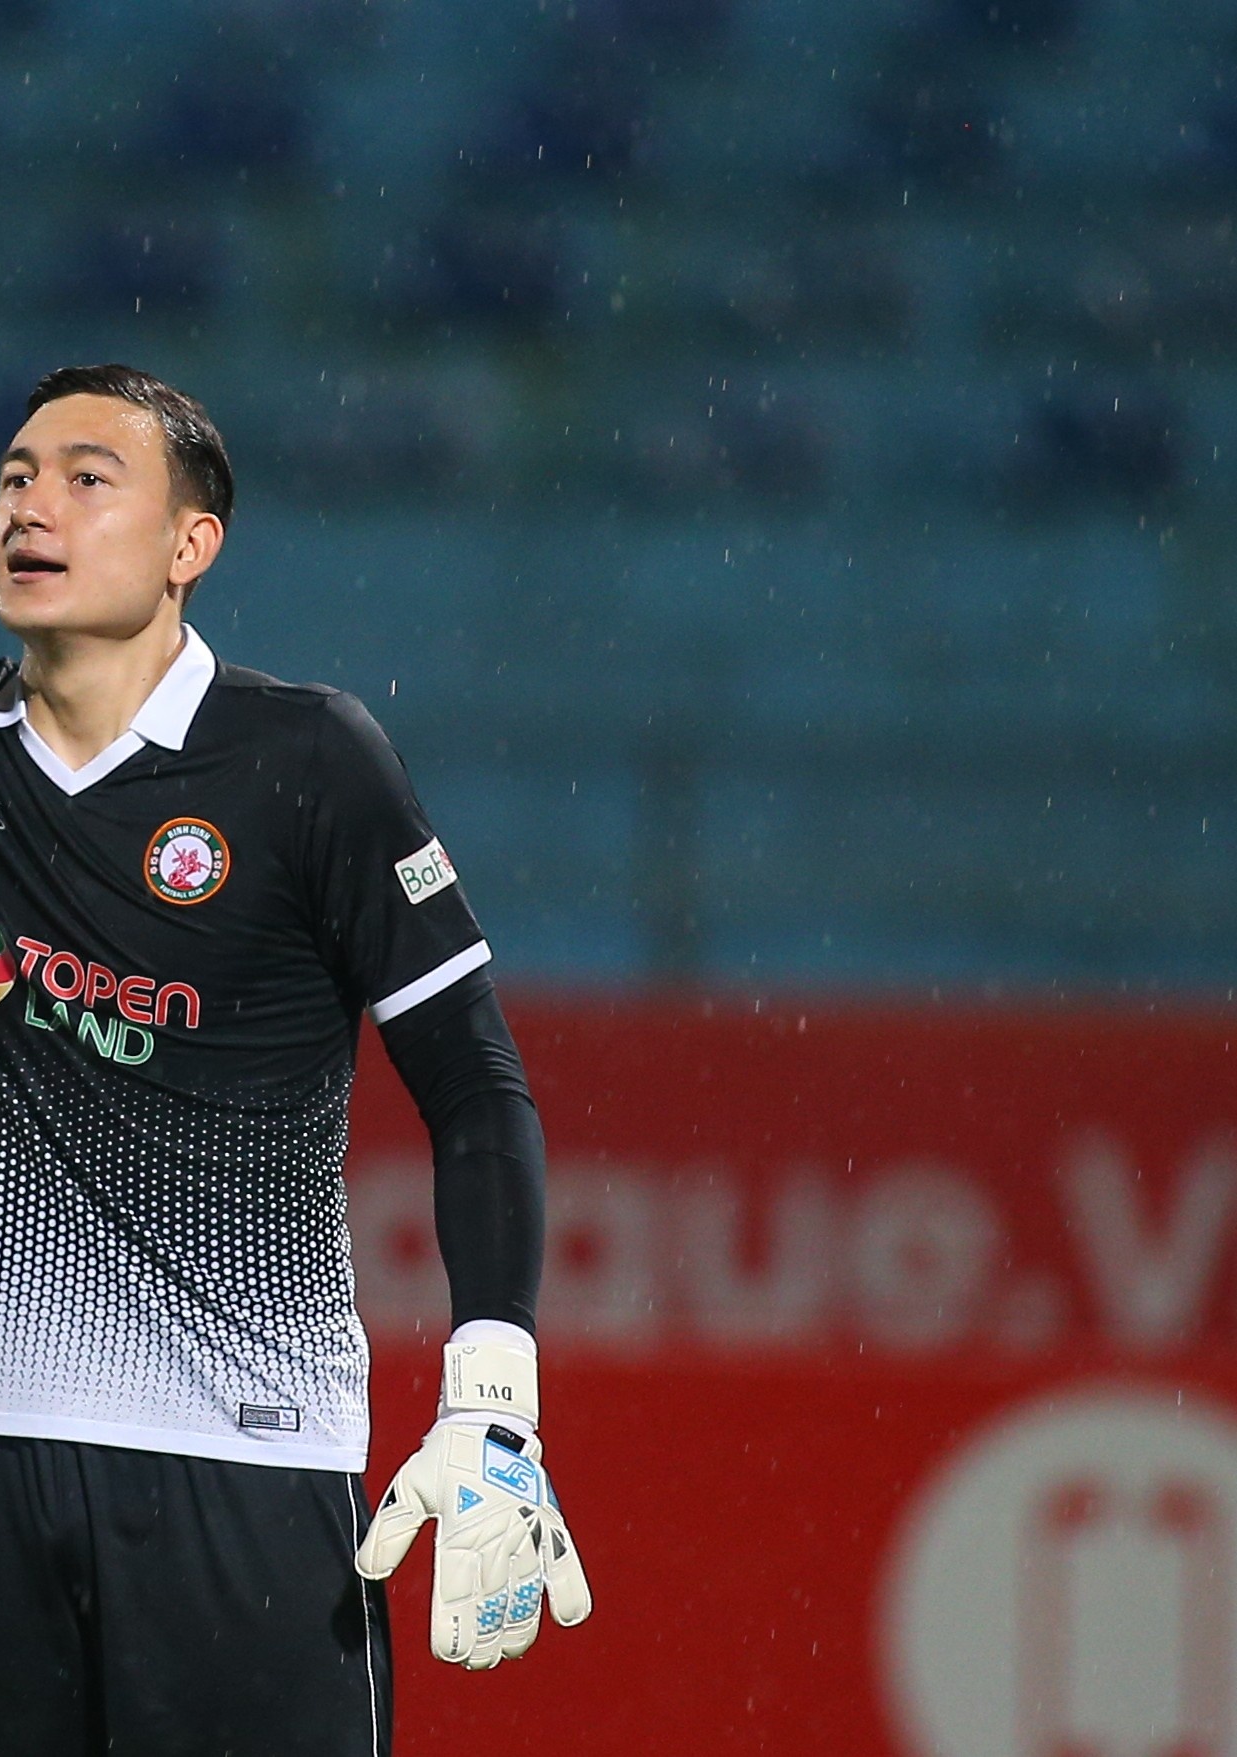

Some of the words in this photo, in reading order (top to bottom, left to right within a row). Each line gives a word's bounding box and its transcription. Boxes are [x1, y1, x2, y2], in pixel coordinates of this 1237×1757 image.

[159, 884, 187, 899] FOOTBALL
[187, 887, 205, 898] CLUB
[16, 935, 201, 1029] TOPEN
[24, 985, 154, 1066] LAND
[475, 1383, 513, 1401] DVL
